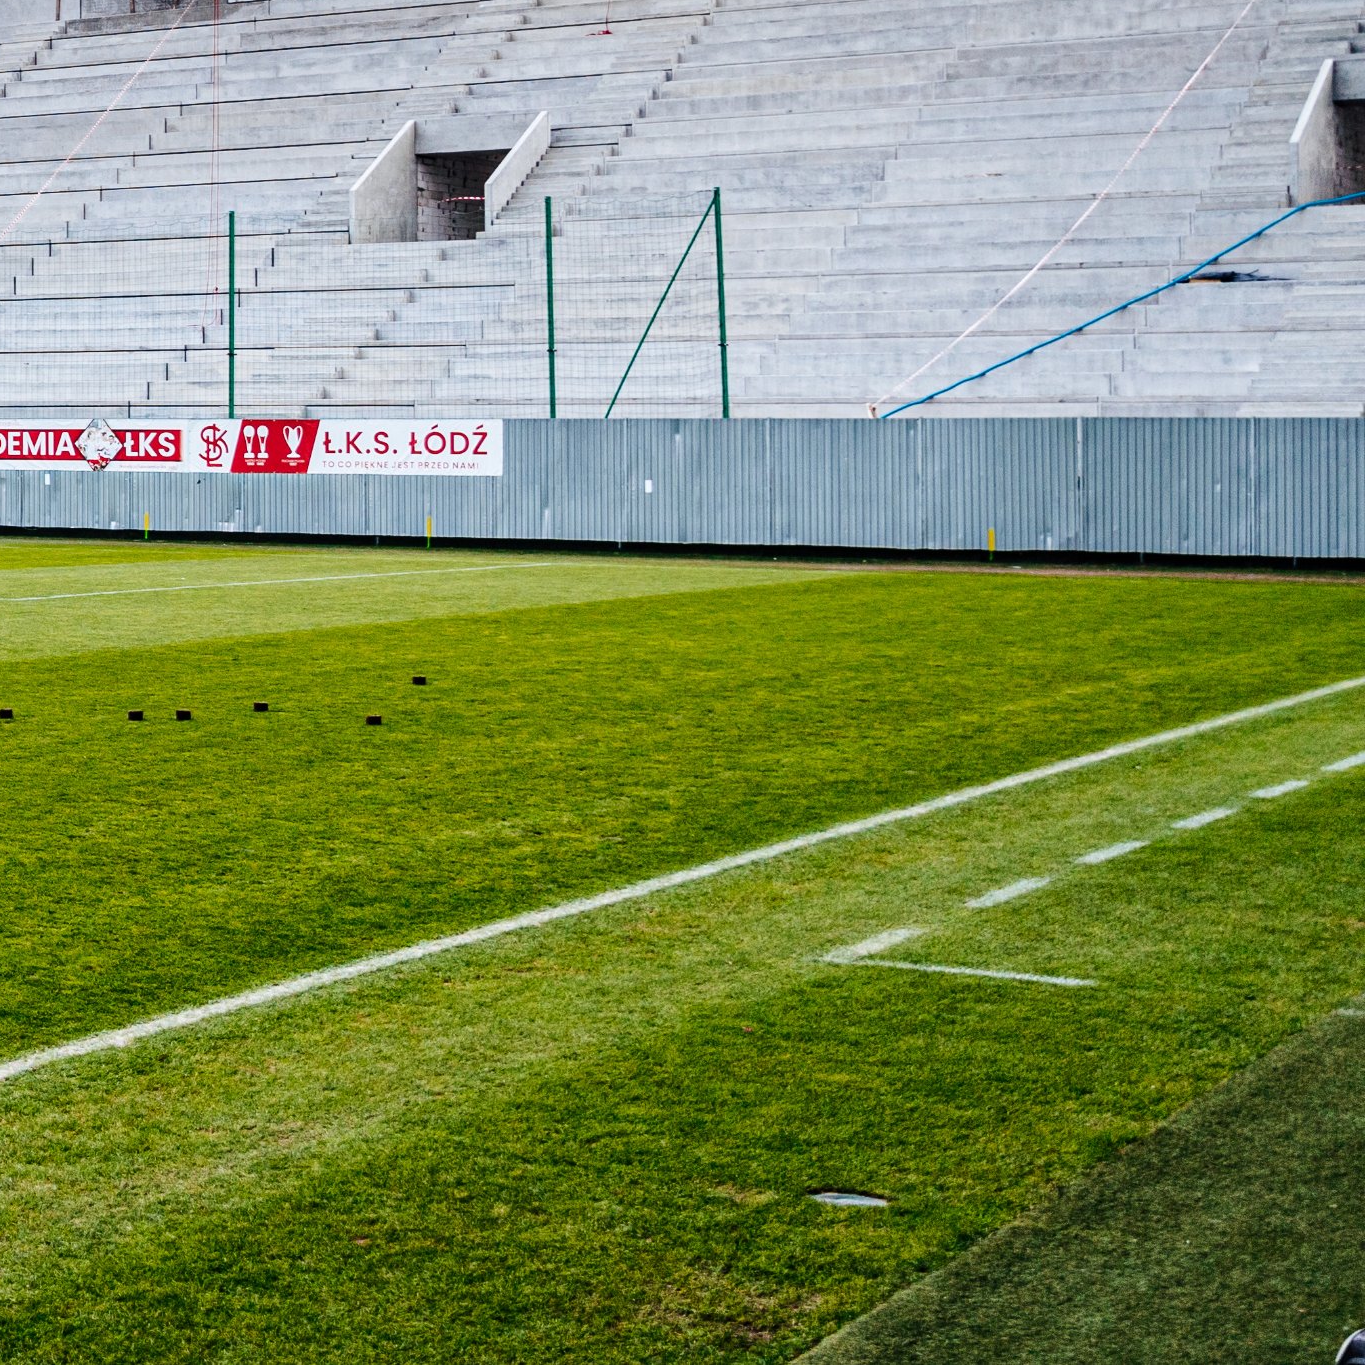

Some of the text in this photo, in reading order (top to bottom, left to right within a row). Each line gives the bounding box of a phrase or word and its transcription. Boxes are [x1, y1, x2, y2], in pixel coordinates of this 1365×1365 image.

[124, 431, 176, 457] ŁKS
[323, 424, 488, 455] Ł.K.S. ŁÓDŹ
[322, 460, 335, 468] TO
[337, 460, 352, 468] CO
[391, 461, 415, 469] JEST
[418, 461, 449, 469] PRZED
